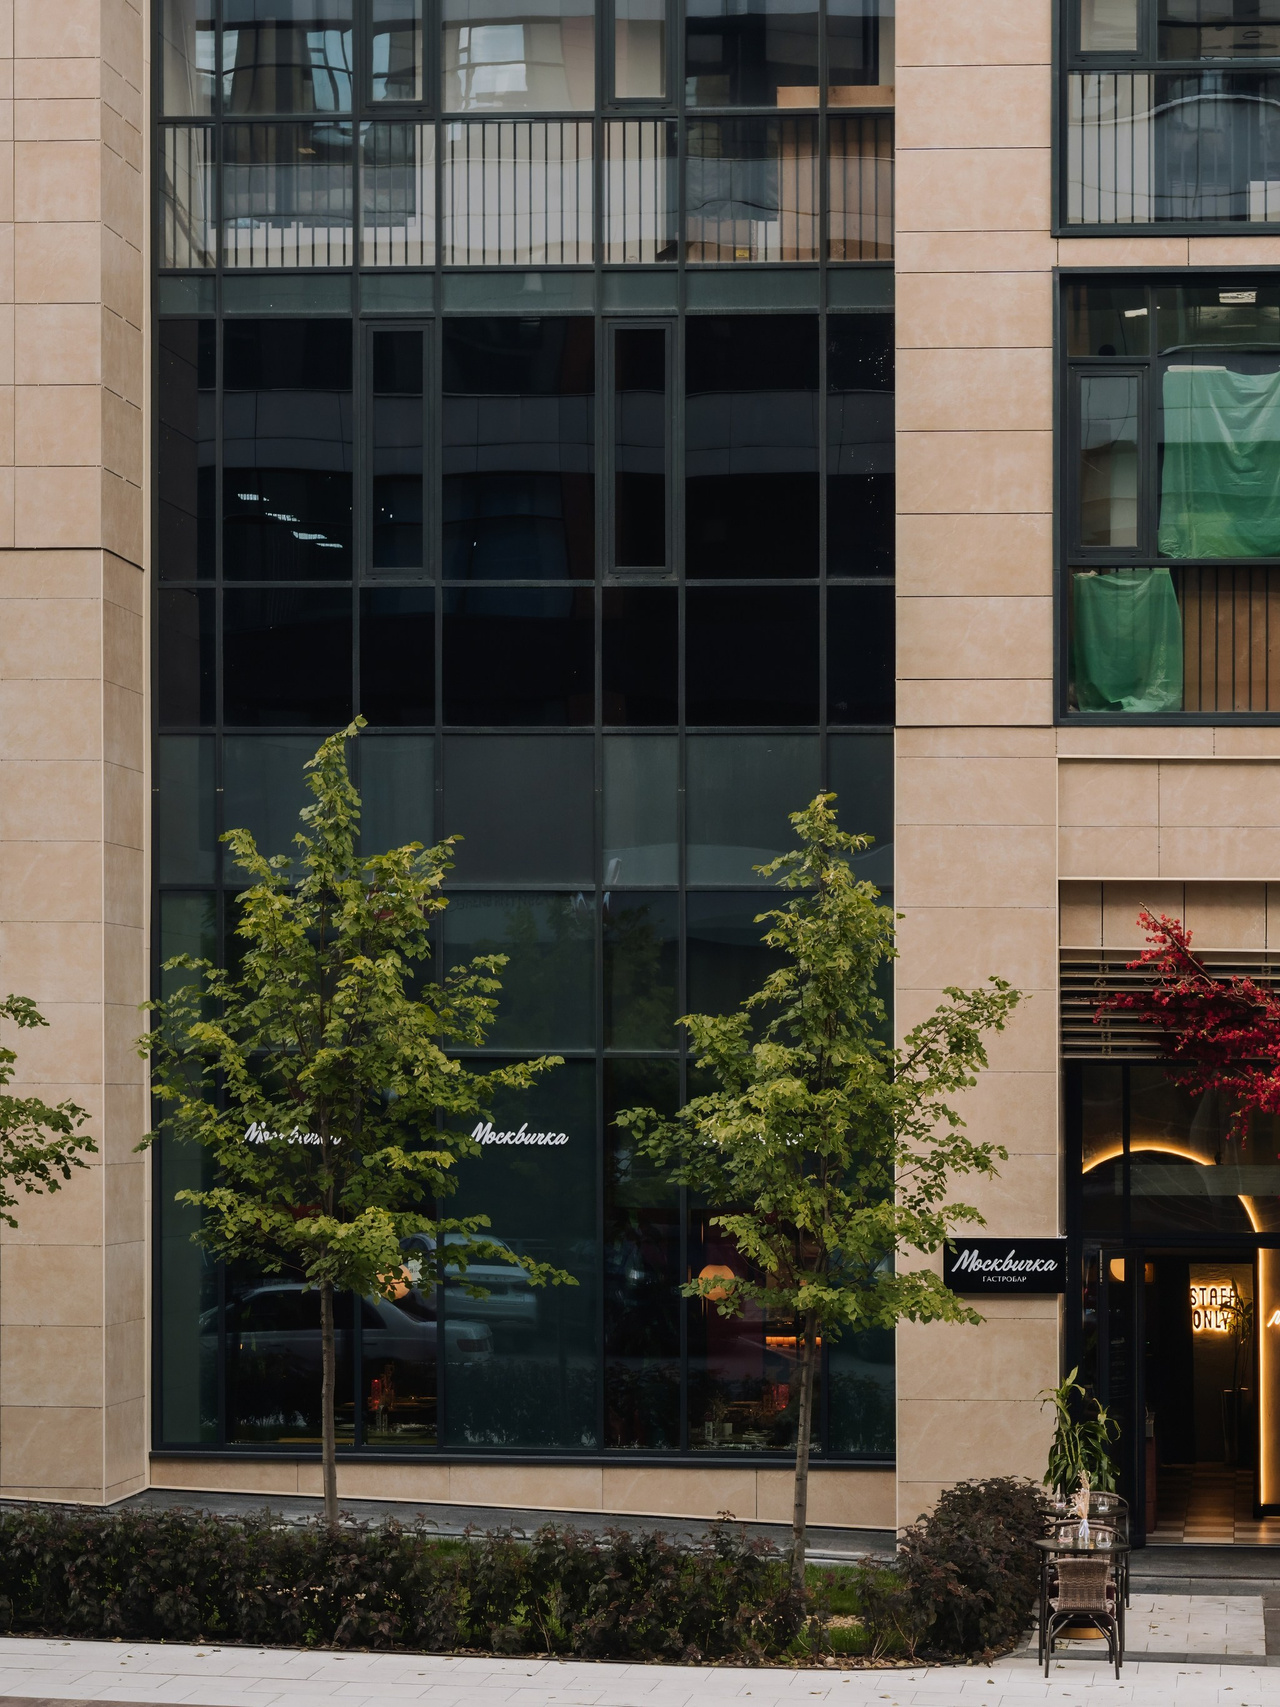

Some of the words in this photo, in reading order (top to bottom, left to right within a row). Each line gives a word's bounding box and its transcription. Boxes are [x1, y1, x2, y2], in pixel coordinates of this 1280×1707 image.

[470, 1121, 570, 1145] Москвичка
[951, 1249, 1058, 1273] Москвичка
[982, 1275, 1027, 1283] ГАСТРОБАР
[1190, 1287, 1237, 1306] STAFF
[1193, 1310, 1230, 1330] ONLY
